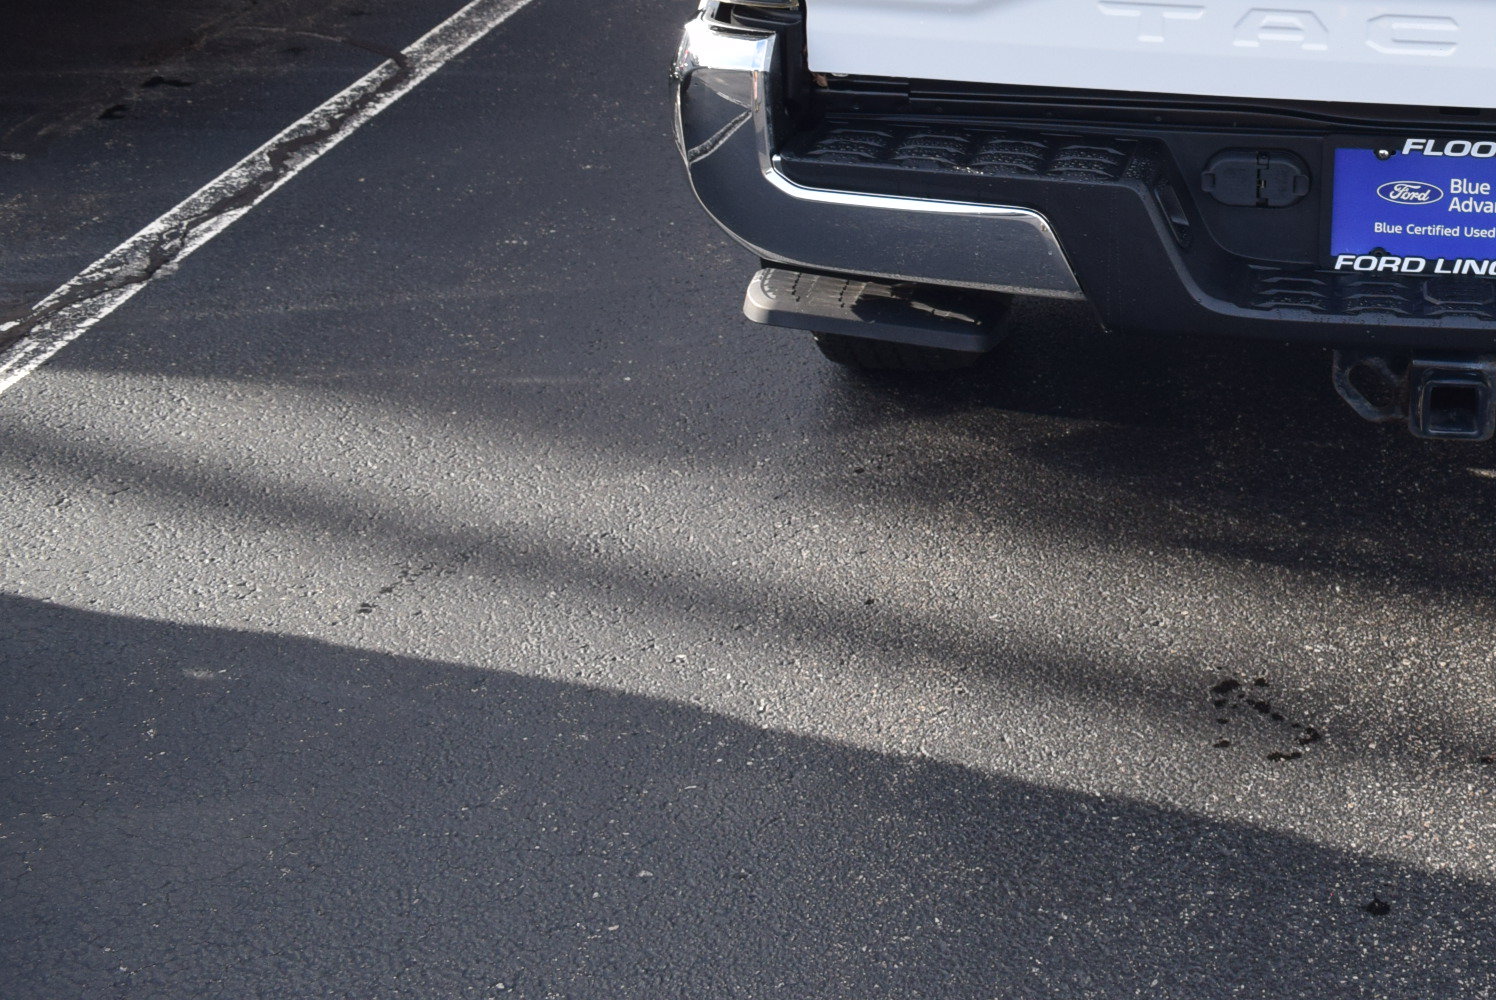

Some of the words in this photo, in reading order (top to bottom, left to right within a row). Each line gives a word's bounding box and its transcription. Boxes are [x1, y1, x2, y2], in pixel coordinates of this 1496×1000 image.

[1389, 183, 1431, 202] Ford
[1450, 178, 1491, 195] Blue
[1374, 222, 1403, 234] Blue
[1406, 223, 1460, 238] Certified
[1464, 226, 1496, 239] Used
[1334, 254, 1426, 273] FORD
